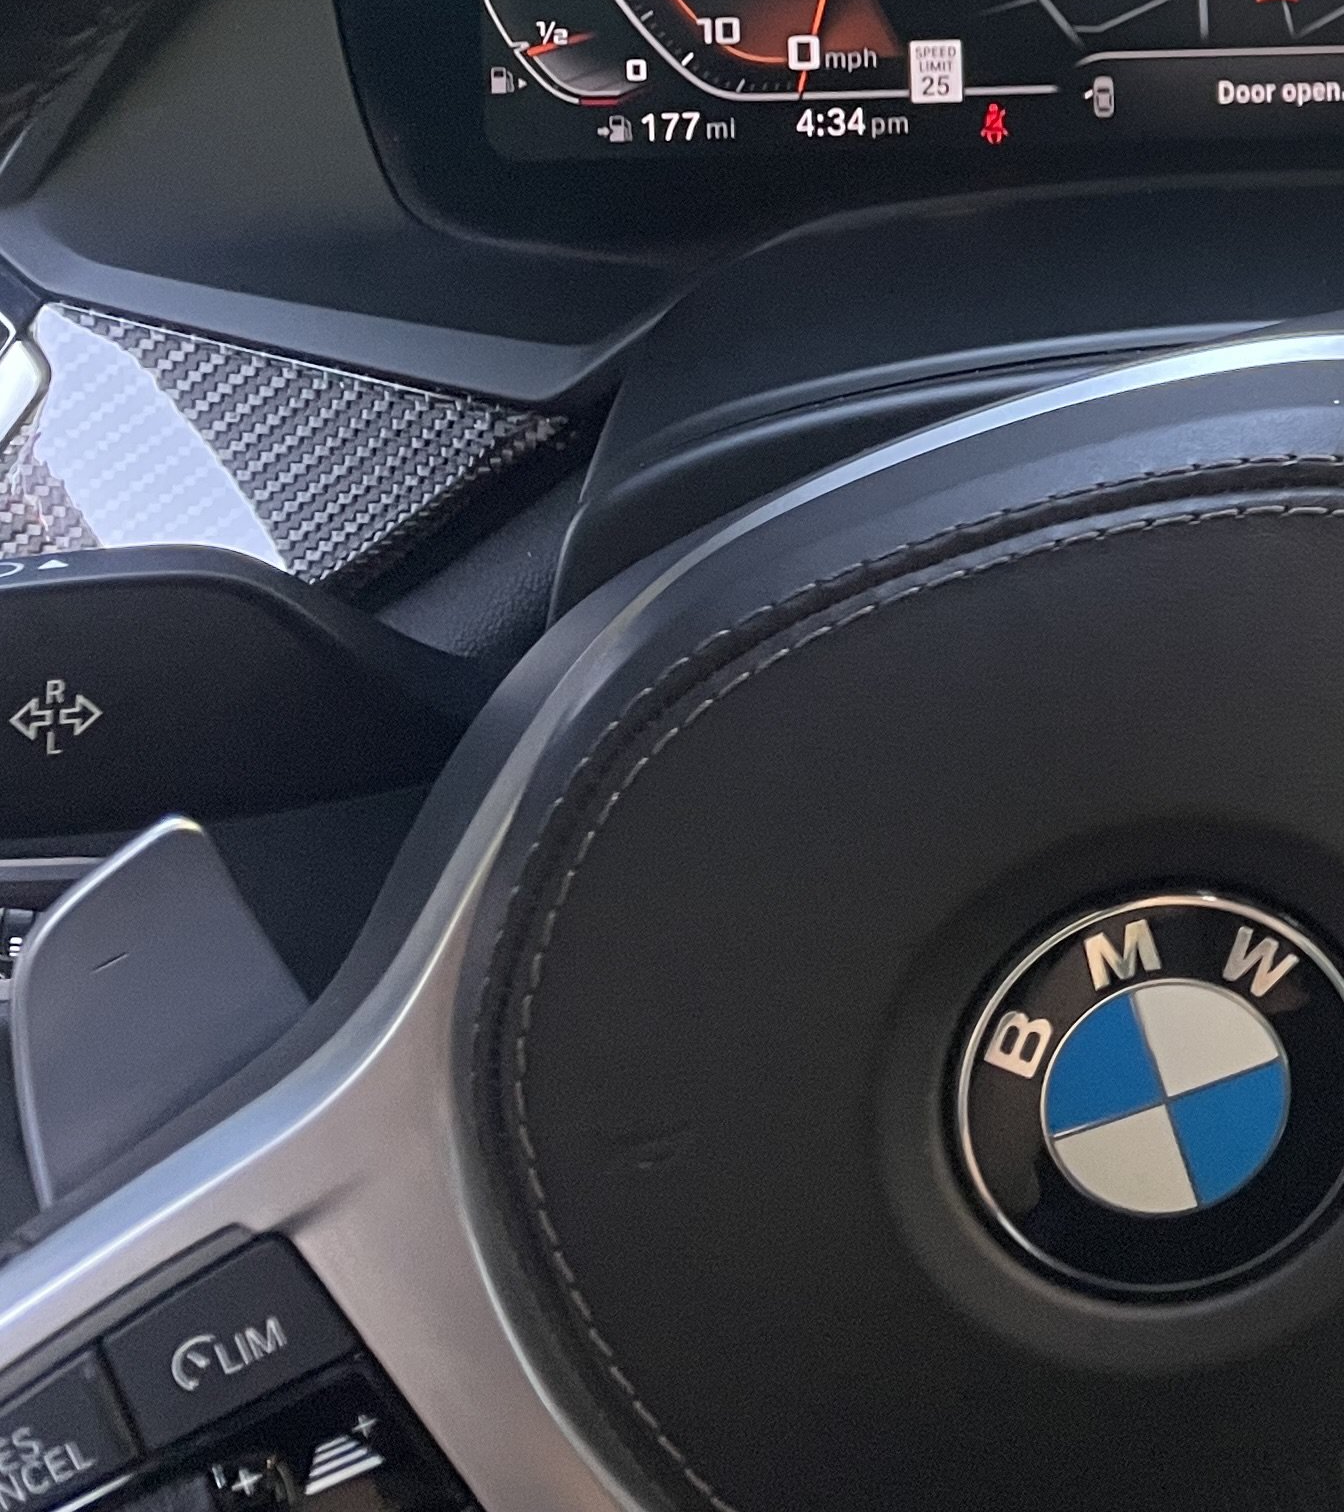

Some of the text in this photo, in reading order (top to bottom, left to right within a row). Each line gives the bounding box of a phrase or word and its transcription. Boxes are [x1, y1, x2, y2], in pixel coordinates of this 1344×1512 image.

[697, 17, 741, 45] 10
[787, 35, 878, 71] 0 mph
[915, 46, 957, 60] SPEED
[625, 59, 648, 82] 0
[919, 60, 954, 74] LIMIT
[921, 76, 951, 97] 25
[1217, 80, 1277, 104] Door
[641, 113, 736, 143] 177 mi
[796, 107, 910, 139] 4:34 pm
[46, 679, 66, 704] R
[46, 732, 62, 755] L
[984, 919, 1299, 1079] BMW
[213, 1316, 287, 1375] LIM
